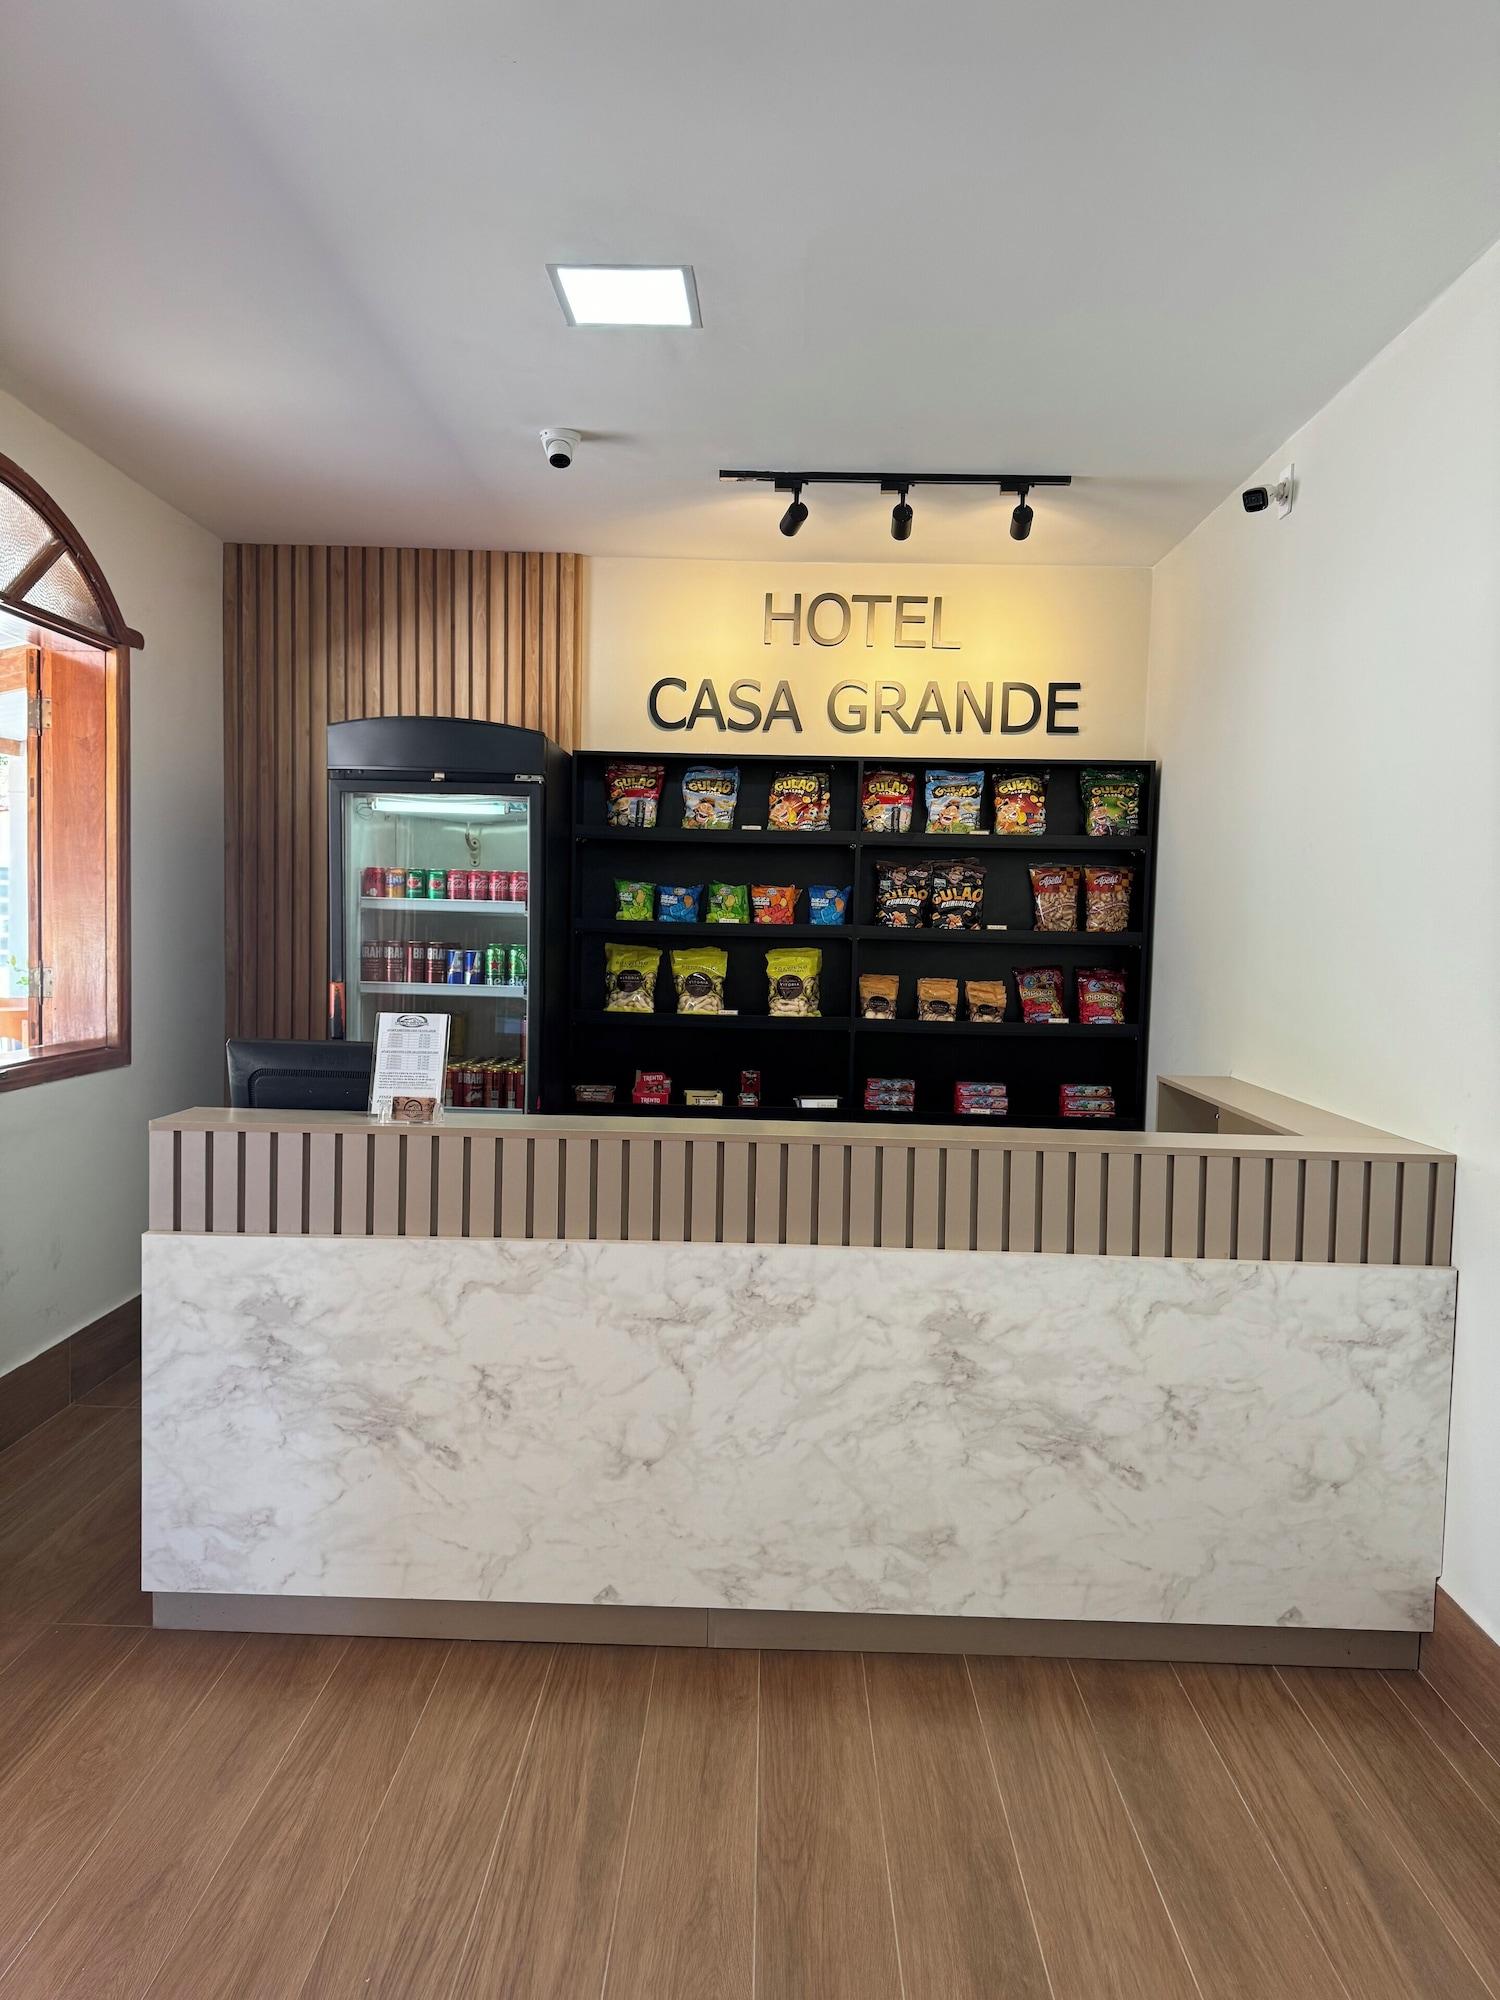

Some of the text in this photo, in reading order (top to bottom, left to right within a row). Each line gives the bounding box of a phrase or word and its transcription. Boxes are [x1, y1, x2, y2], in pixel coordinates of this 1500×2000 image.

[764, 592, 961, 650] HOTEL
[646, 677, 1081, 735] CASA GRANDE
